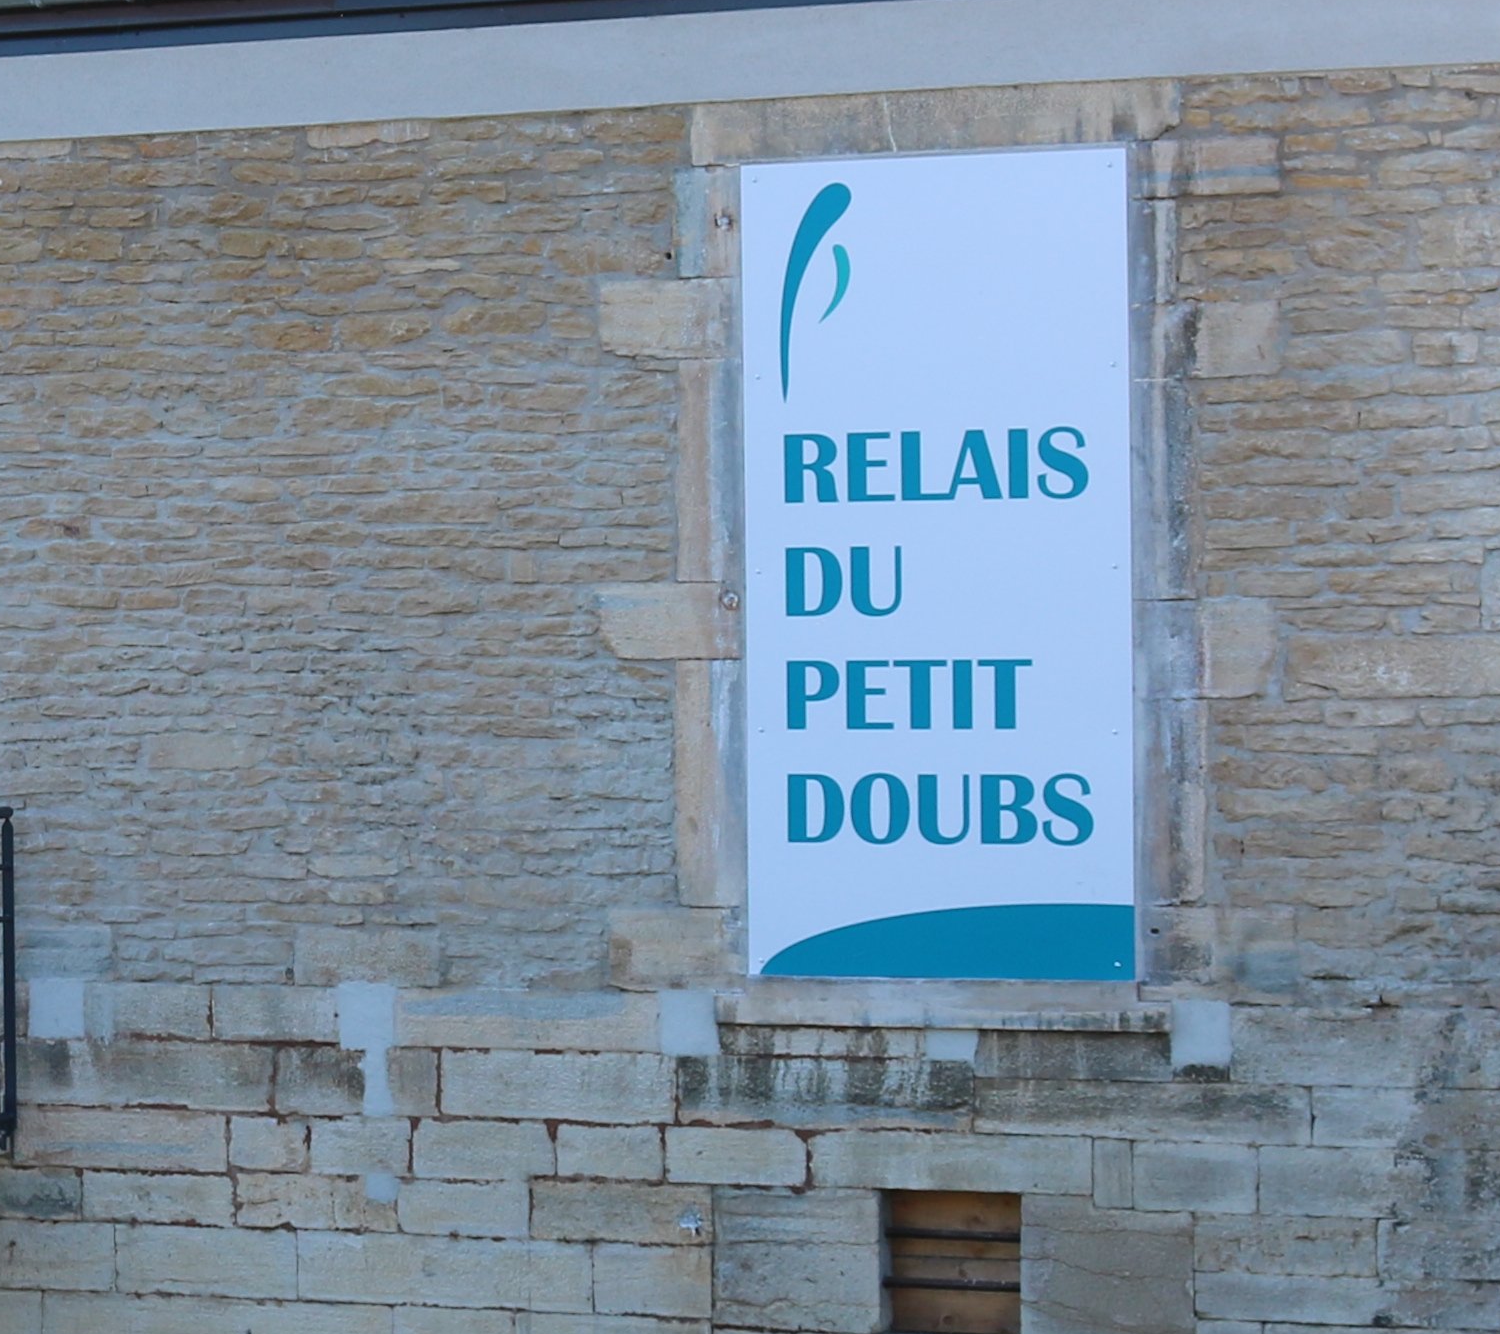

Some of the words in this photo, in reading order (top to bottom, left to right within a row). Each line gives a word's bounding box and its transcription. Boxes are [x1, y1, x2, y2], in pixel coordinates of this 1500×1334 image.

[783, 426, 1090, 504] RELAIS
[784, 545, 903, 618] DU
[786, 658, 1033, 731] PETIT
[786, 772, 1095, 847] DOUBS
